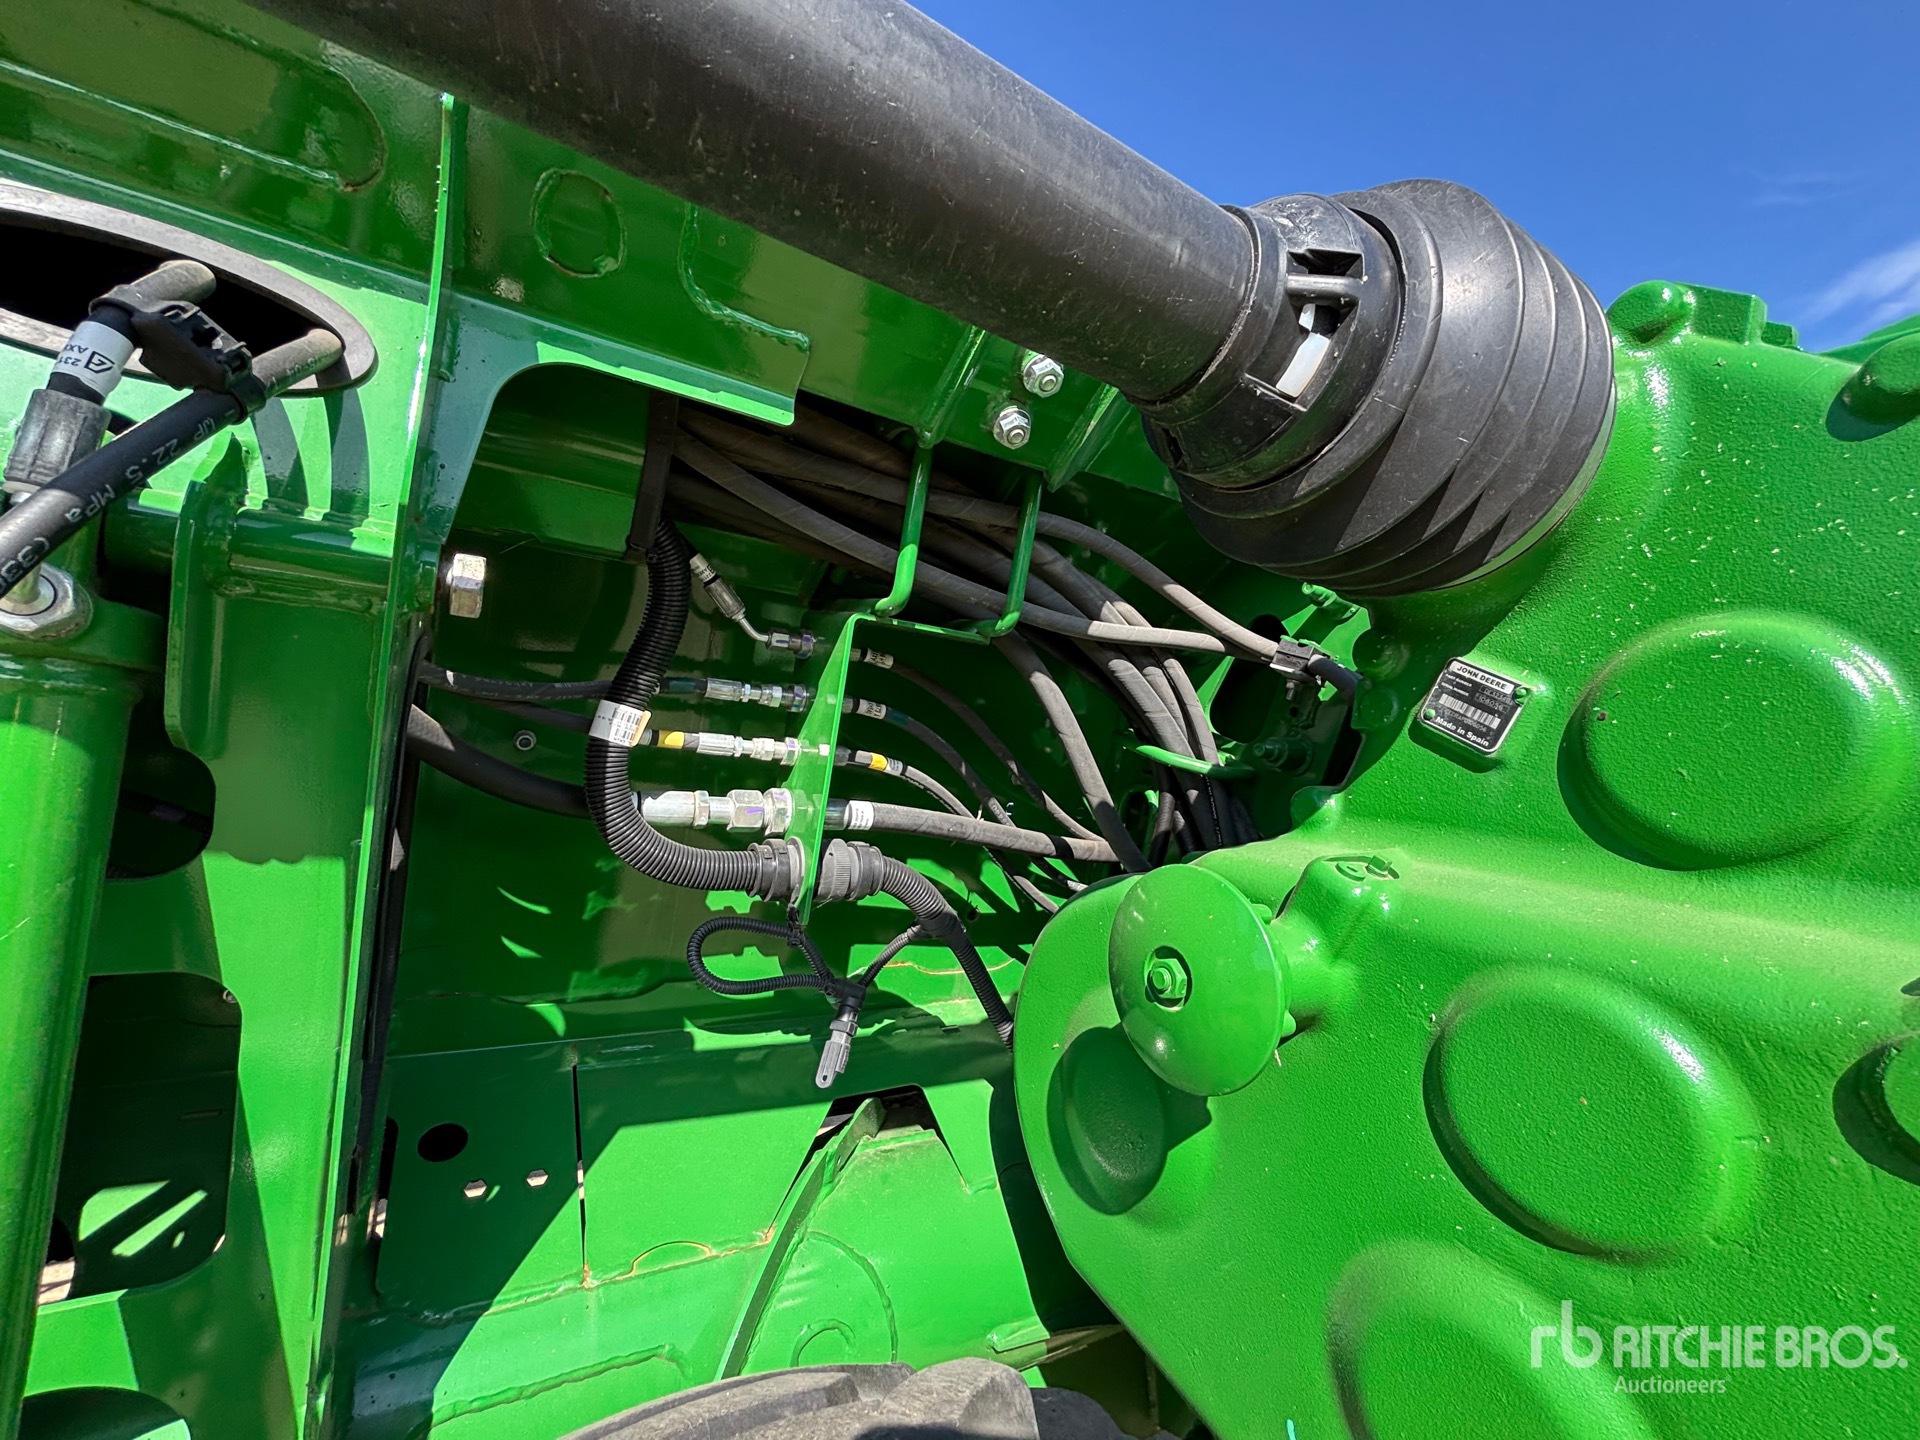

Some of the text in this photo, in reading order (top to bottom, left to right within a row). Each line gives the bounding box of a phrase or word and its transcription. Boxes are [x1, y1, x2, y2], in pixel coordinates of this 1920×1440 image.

[125, 438, 178, 485] 22.5
[64, 484, 116, 523] MPa
[1456, 665, 1507, 690] JOHN DEERE
[1435, 716, 1490, 747] Made in Spain
